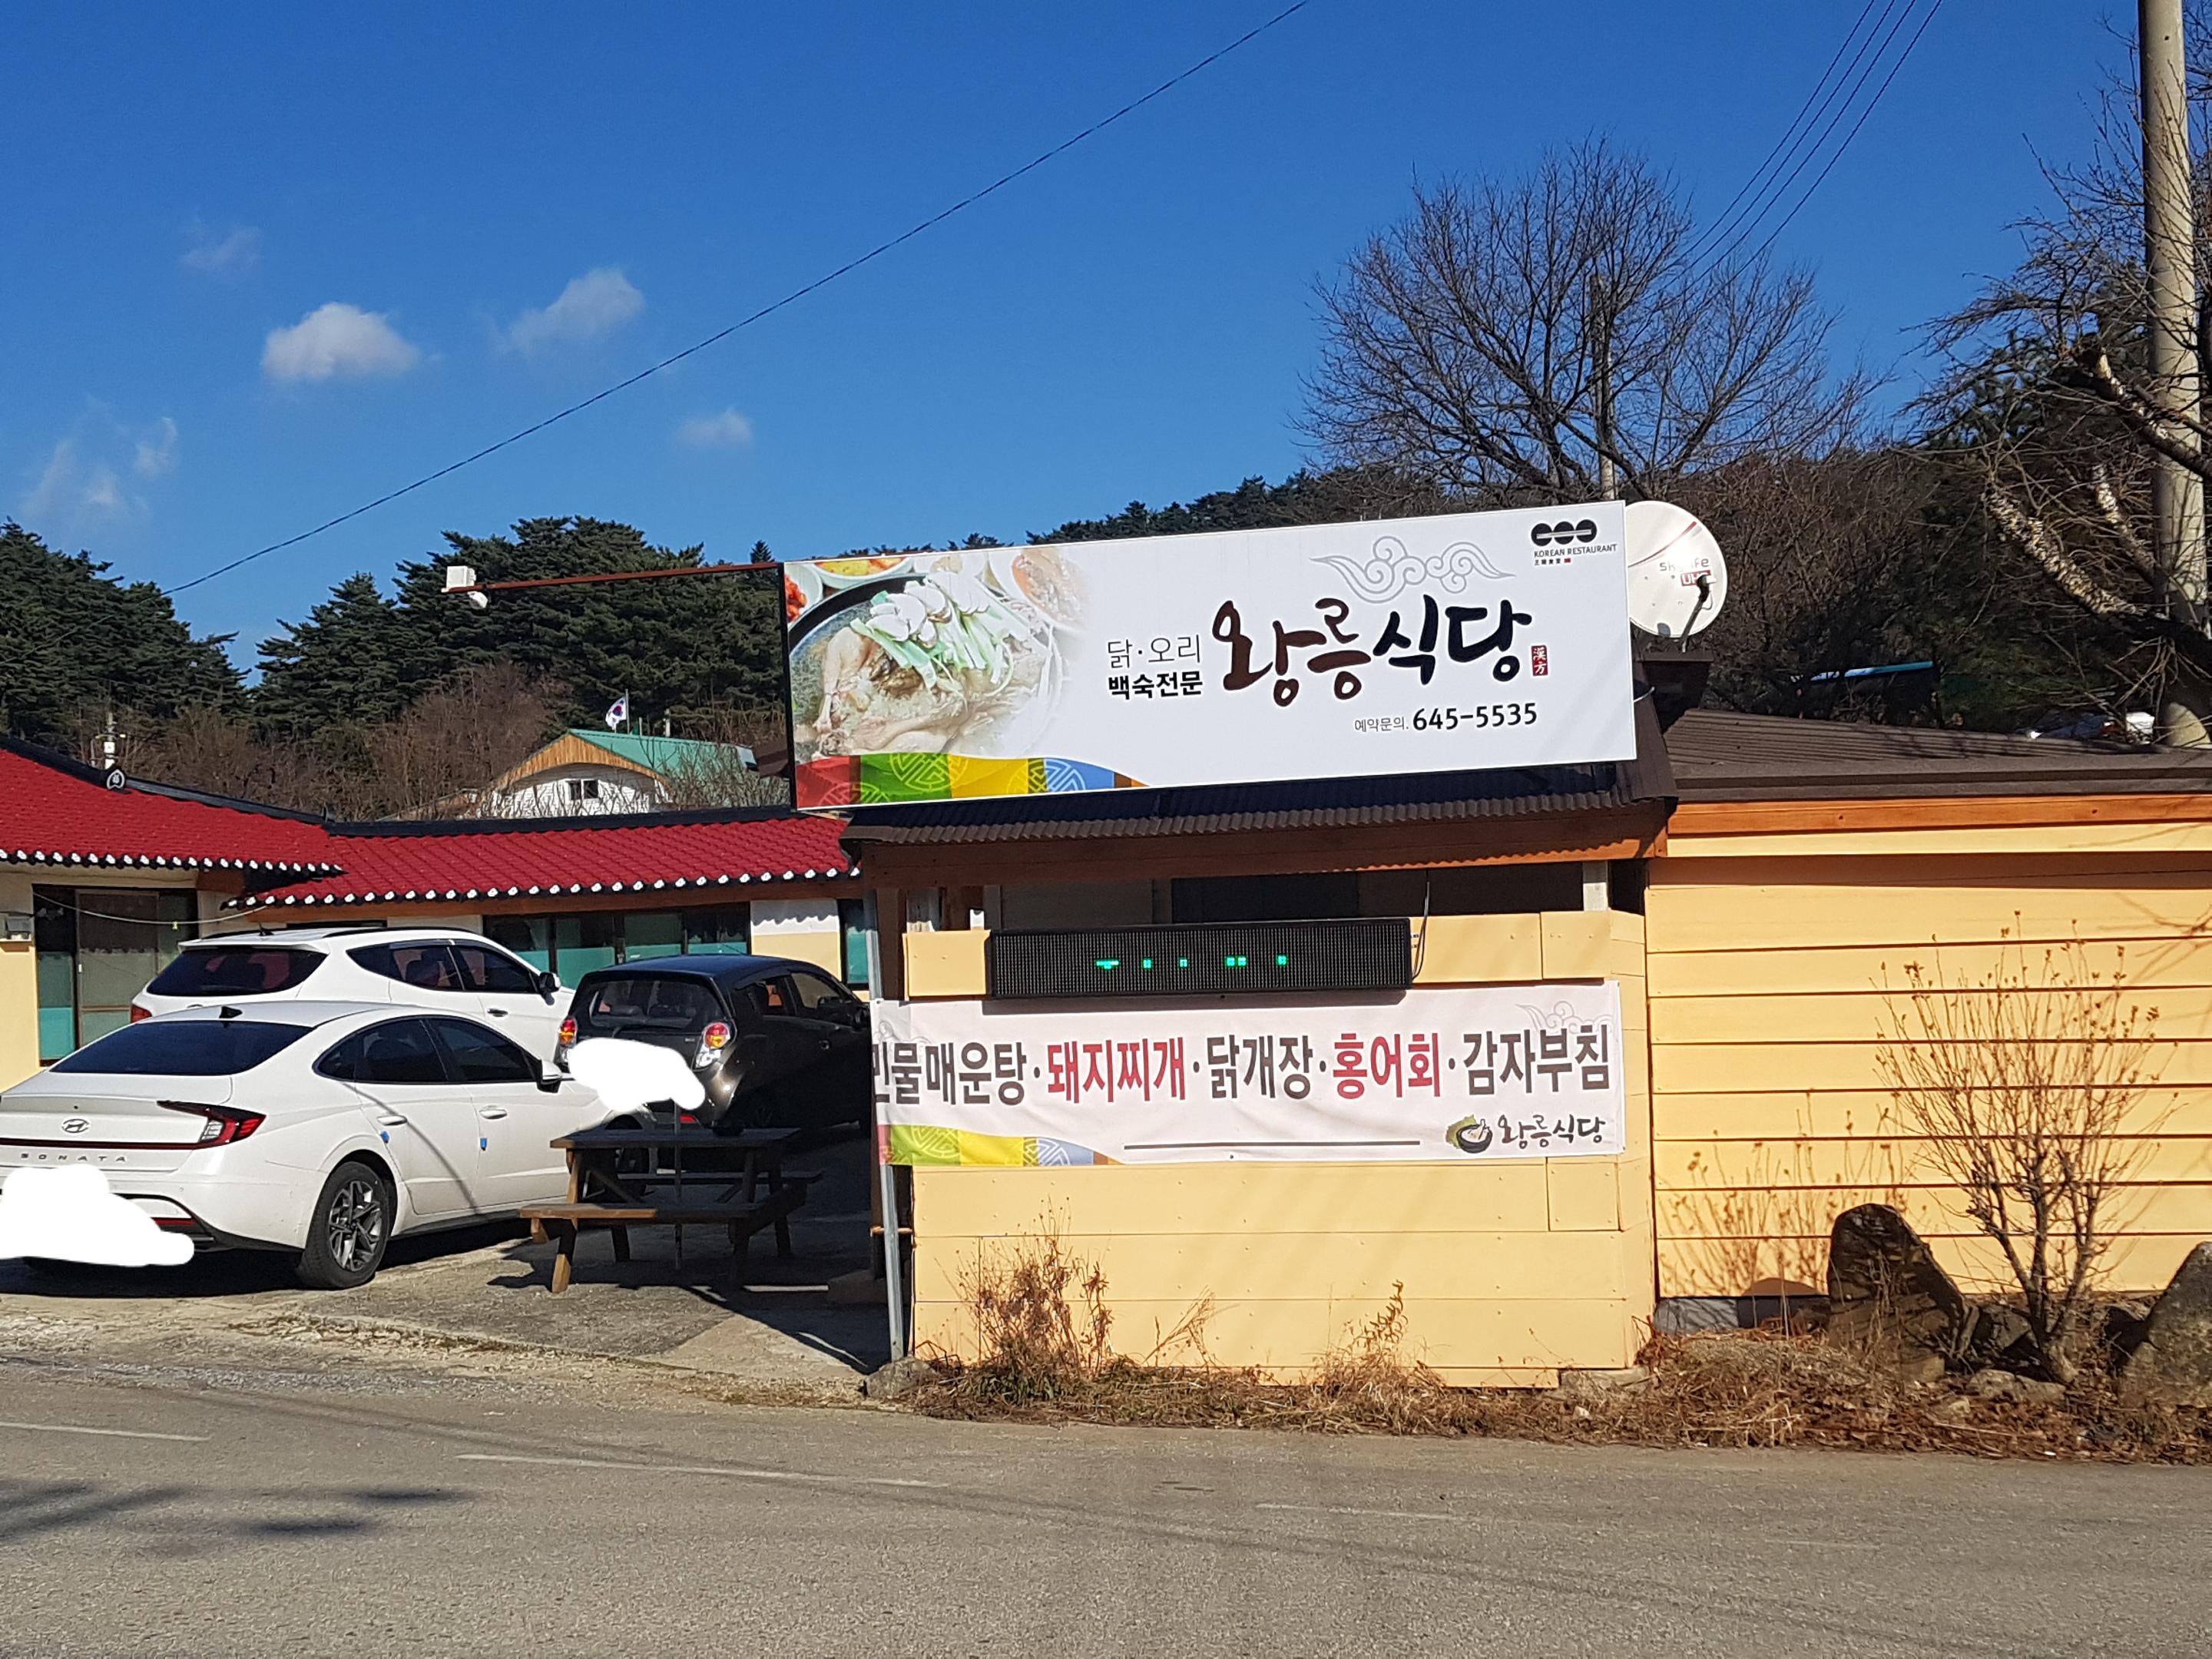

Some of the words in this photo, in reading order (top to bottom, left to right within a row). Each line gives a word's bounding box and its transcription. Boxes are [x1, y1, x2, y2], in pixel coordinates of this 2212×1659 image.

[1534, 548, 1565, 558] KOREAN
[1567, 543, 1618, 555] RESTAURANT
[1212, 594, 1533, 707] 왕릉식당
[1108, 671, 1204, 700] 백숙전문
[1412, 702, 1538, 730] 645-5535
[1497, 1114, 1607, 1150] 왕릉식당
[20, 1153, 126, 1162] SONATA
